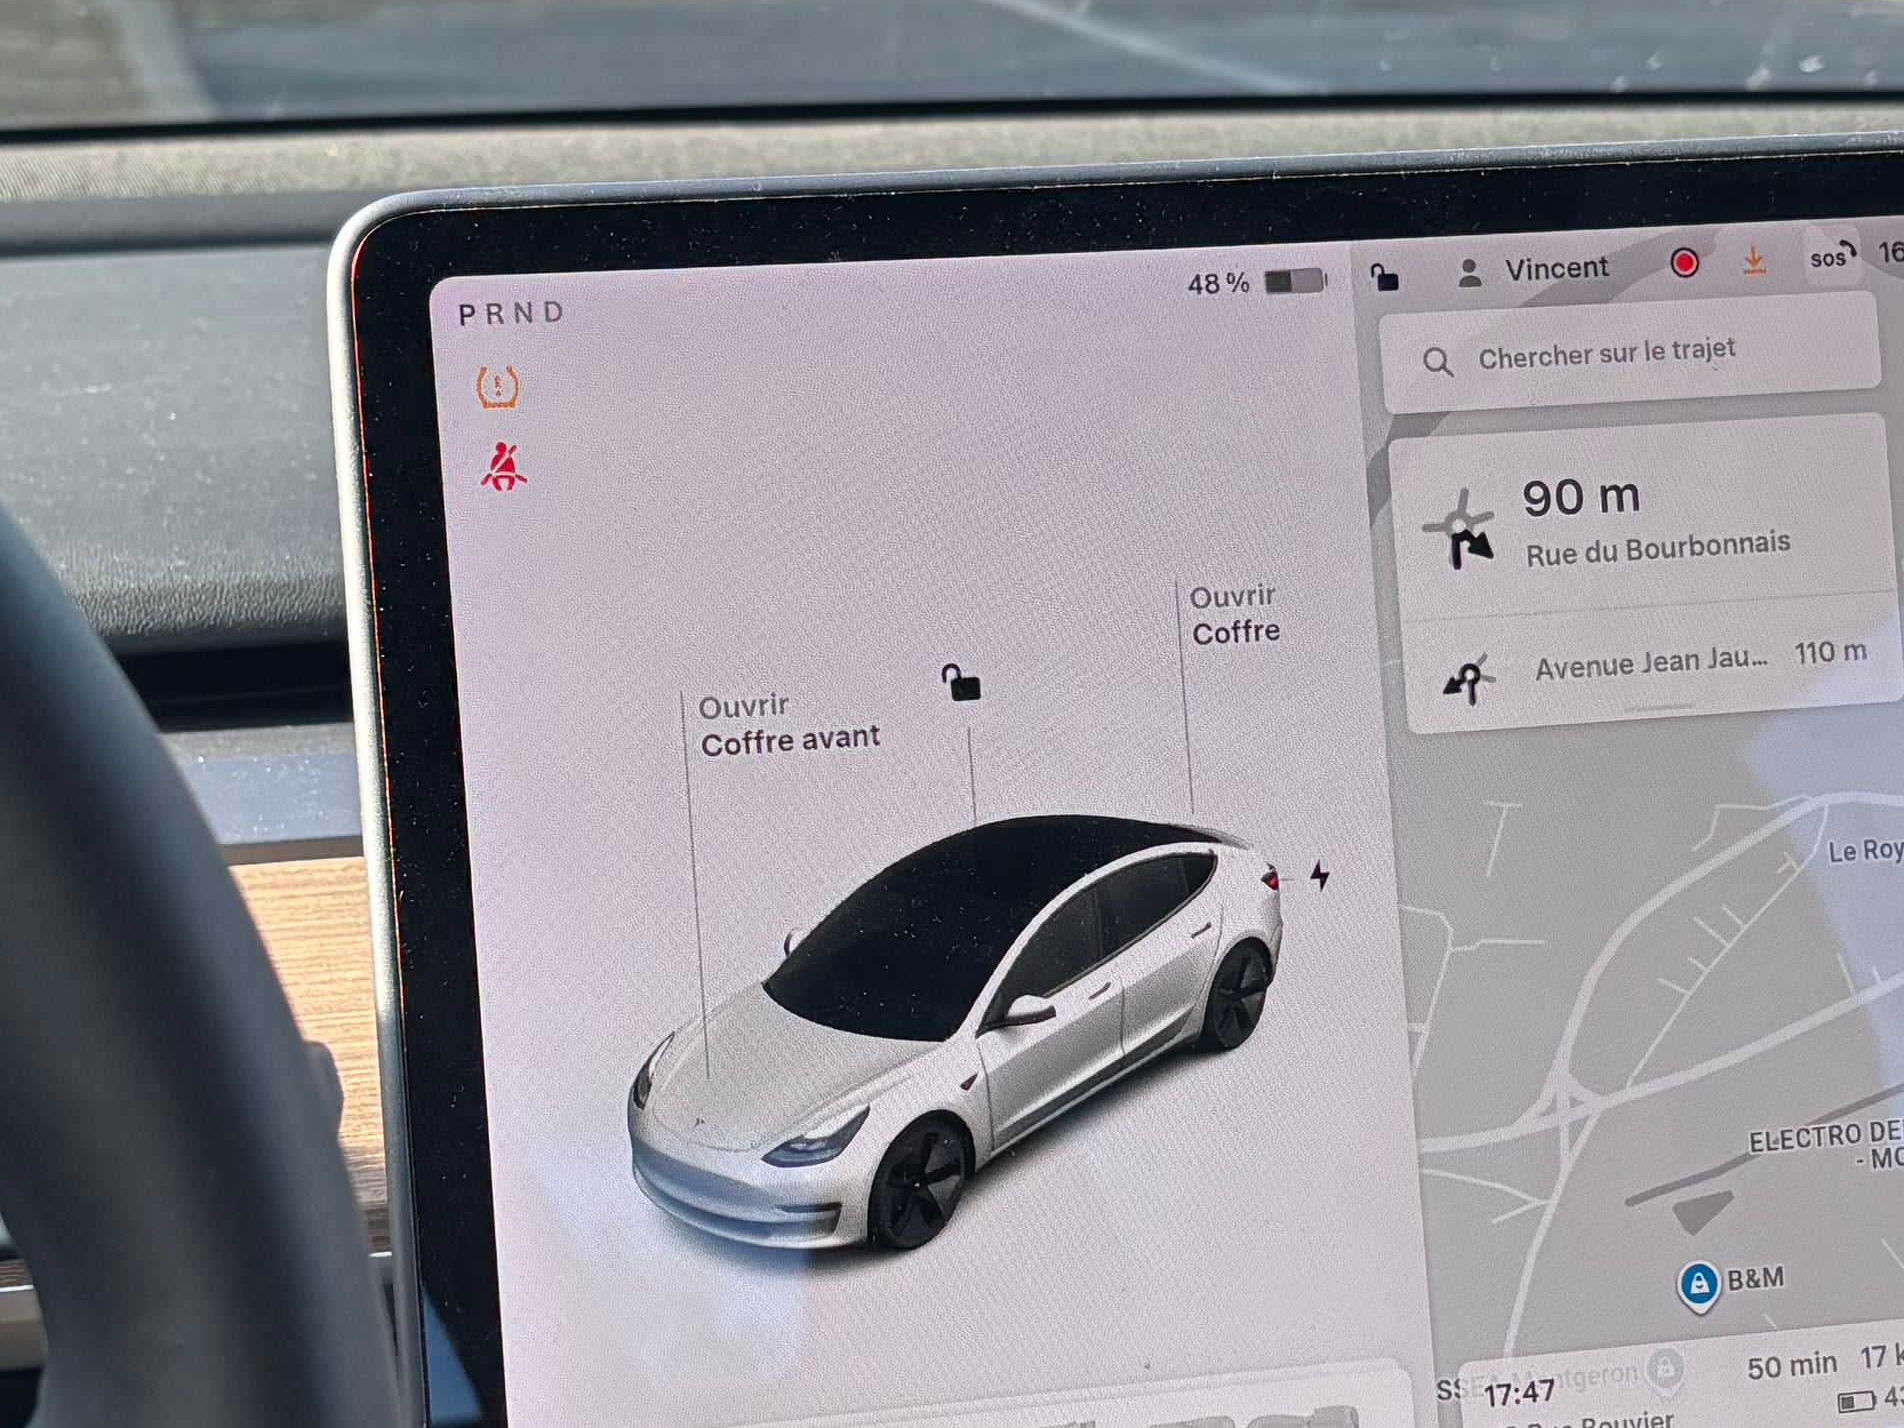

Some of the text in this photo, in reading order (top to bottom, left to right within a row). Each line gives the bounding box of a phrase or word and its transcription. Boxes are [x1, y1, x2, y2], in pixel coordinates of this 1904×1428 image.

[1506, 255, 1611, 282] Vincent
[1478, 335, 1737, 371] Chercher sur le trajet
[1523, 478, 1641, 517] 90 m
[1527, 530, 1791, 568] Rue du Bourbonnais
[1190, 583, 1276, 609] Ouvrir
[1192, 618, 1281, 645] Coffre
[1536, 654, 1634, 681] Avenue
[1641, 650, 1700, 675] Jean
[1795, 639, 1868, 664] 110 m
[699, 692, 789, 720] Ouvrir
[701, 724, 881, 757] Coffre avant
[1829, 842, 1855, 863] Le
[1749, 1123, 1862, 1153] ELECTRO
[1727, 1266, 1784, 1291] B&M
[1748, 1356, 1782, 1380] 50
[1790, 1350, 1838, 1377] min
[1861, 1345, 1887, 1369] 17
[1485, 1378, 1555, 1407] 17:47
